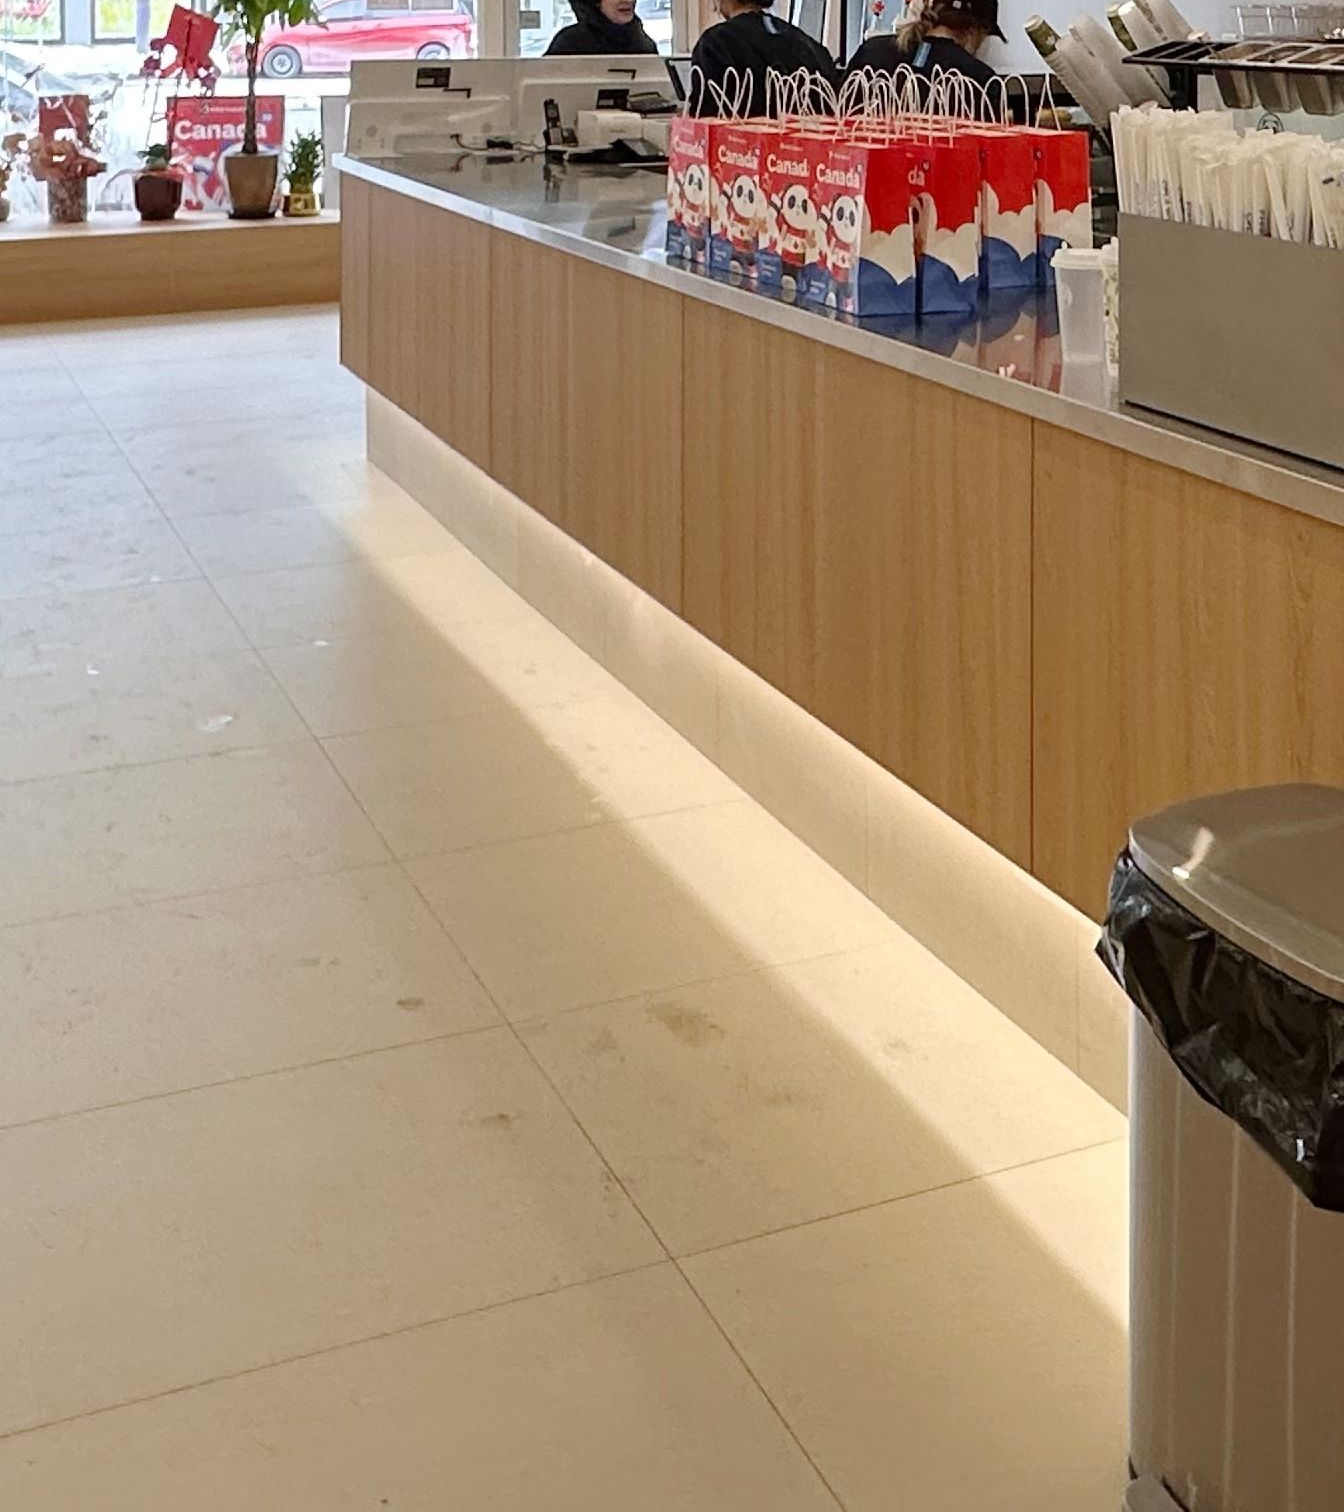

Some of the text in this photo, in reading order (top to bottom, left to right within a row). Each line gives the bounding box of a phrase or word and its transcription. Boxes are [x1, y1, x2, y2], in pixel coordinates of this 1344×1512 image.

[717, 144, 758, 170] Canada
[766, 154, 810, 177] Canad
[815, 162, 861, 189] Canada
